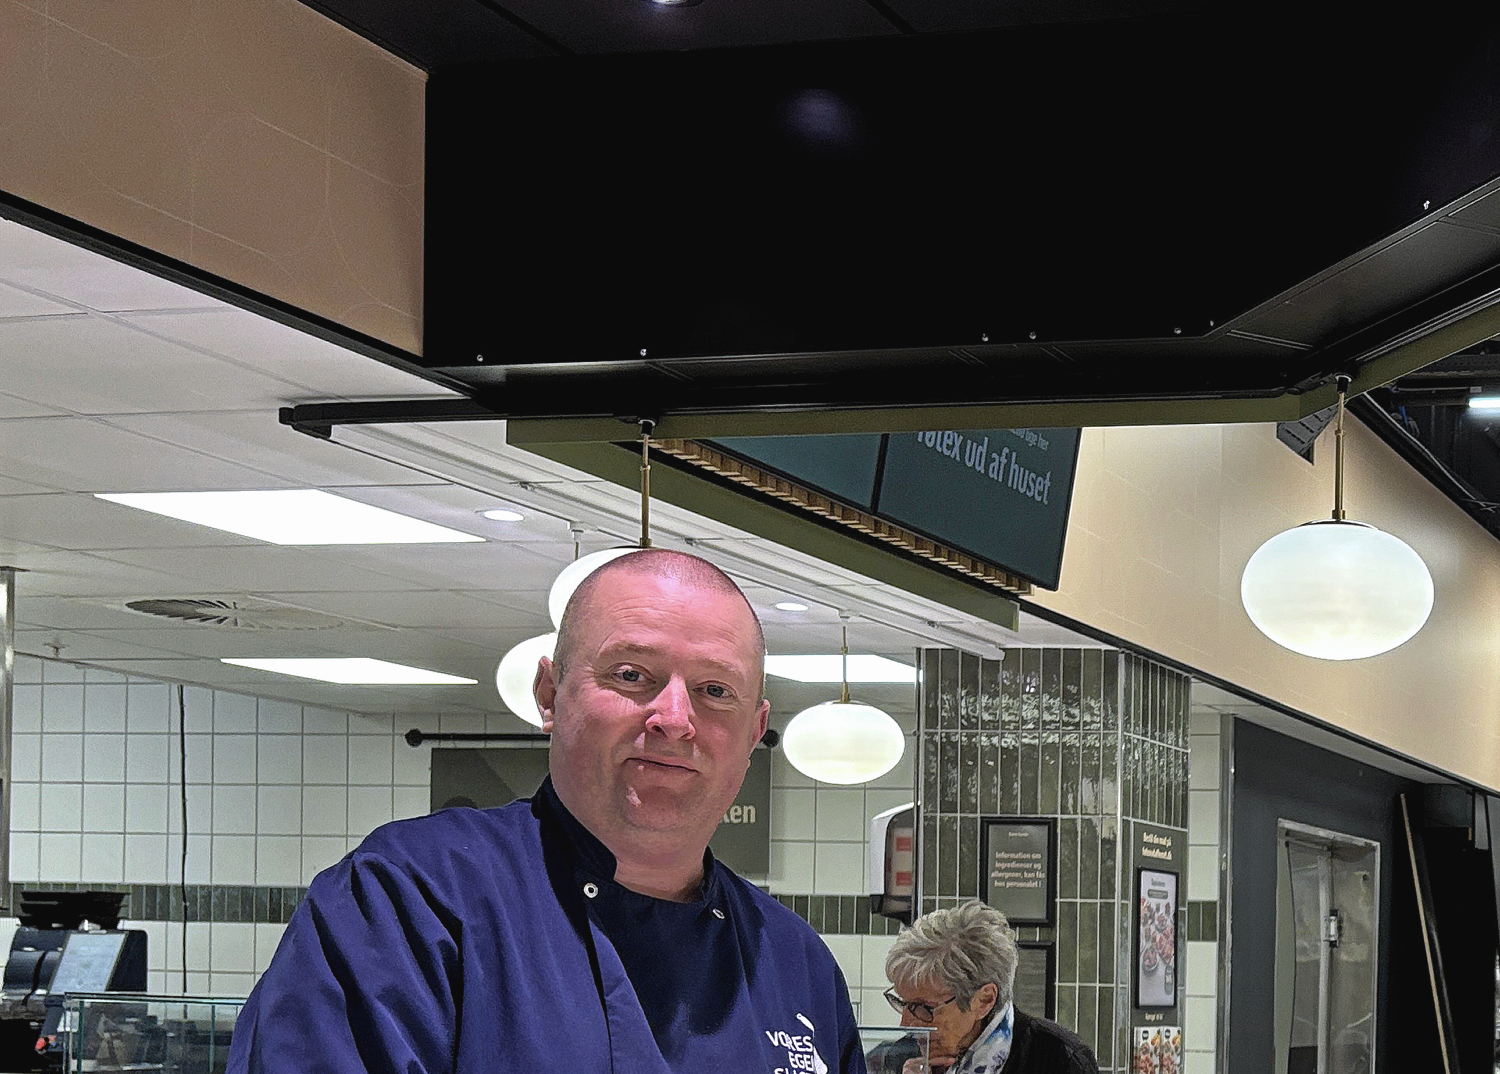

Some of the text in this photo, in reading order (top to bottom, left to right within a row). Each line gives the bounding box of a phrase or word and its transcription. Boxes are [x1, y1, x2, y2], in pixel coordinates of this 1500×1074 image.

[964, 436, 989, 474] ud
[988, 446, 1010, 483] af
[1007, 451, 1052, 506] huset
